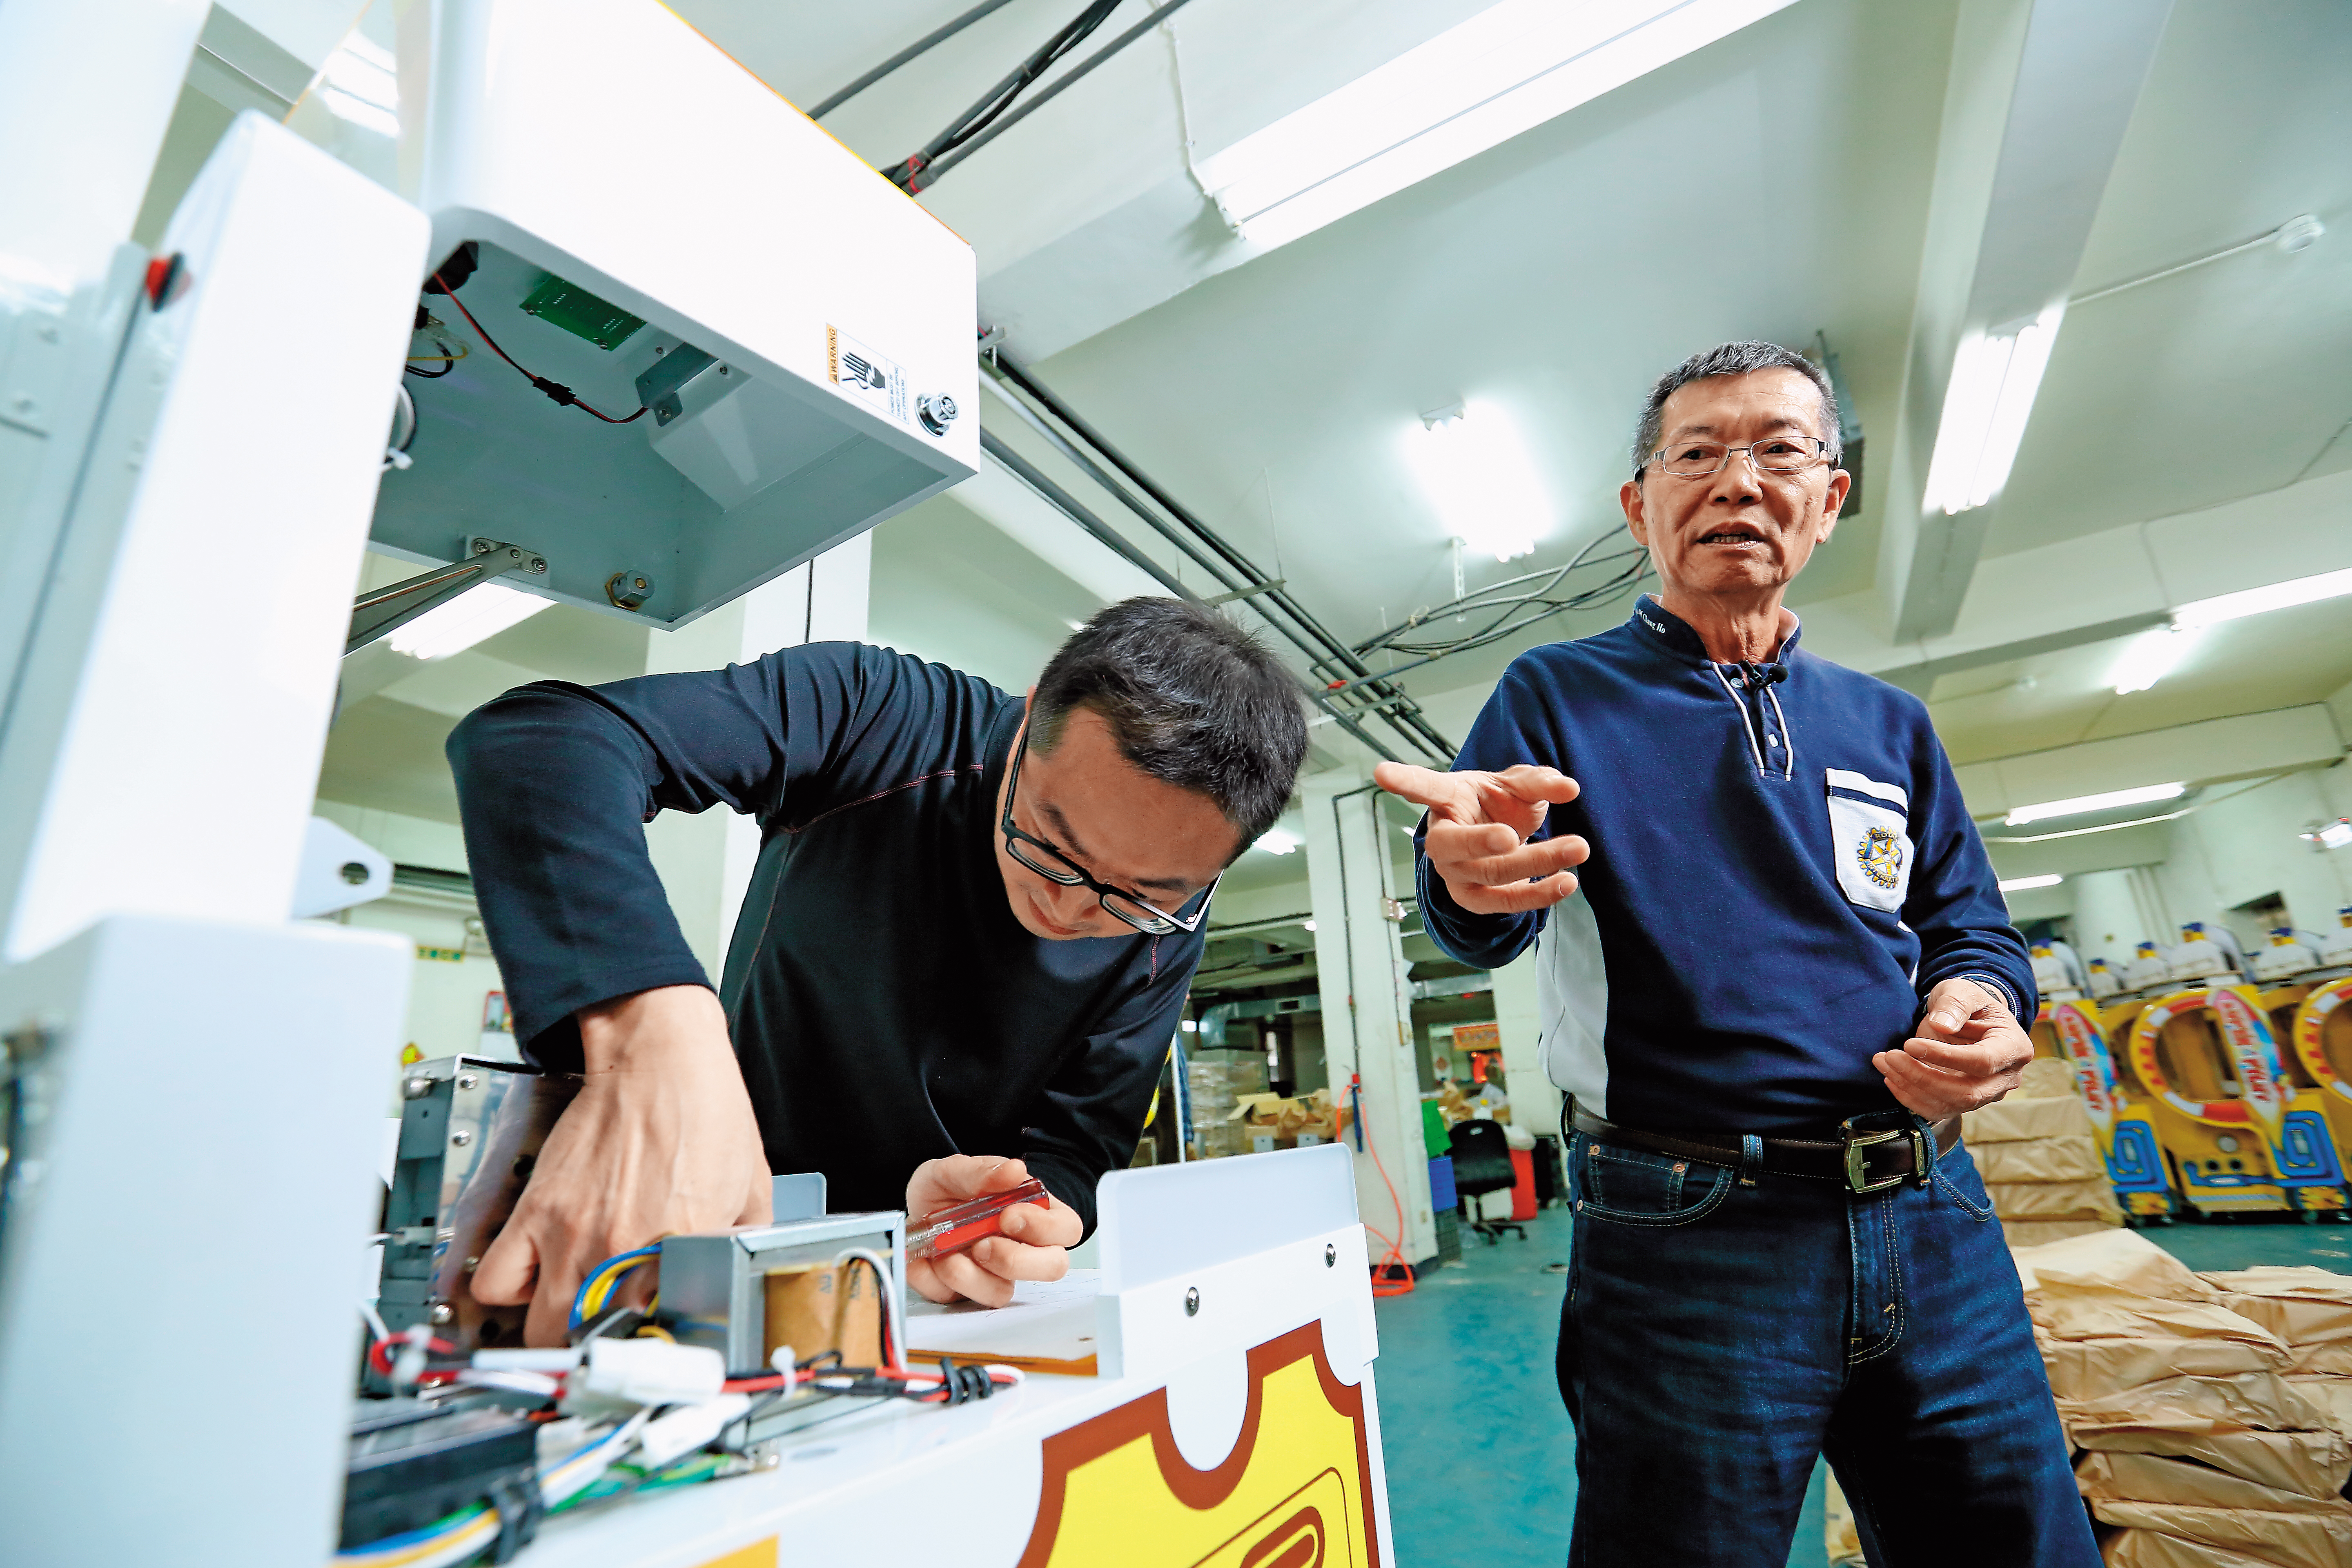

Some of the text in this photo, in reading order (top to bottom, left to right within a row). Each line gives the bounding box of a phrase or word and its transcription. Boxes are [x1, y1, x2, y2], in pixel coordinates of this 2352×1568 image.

[829, 327, 837, 372] WARNING
[1643, 613, 1656, 630] Chung
[1656, 622, 1665, 633] Ho
